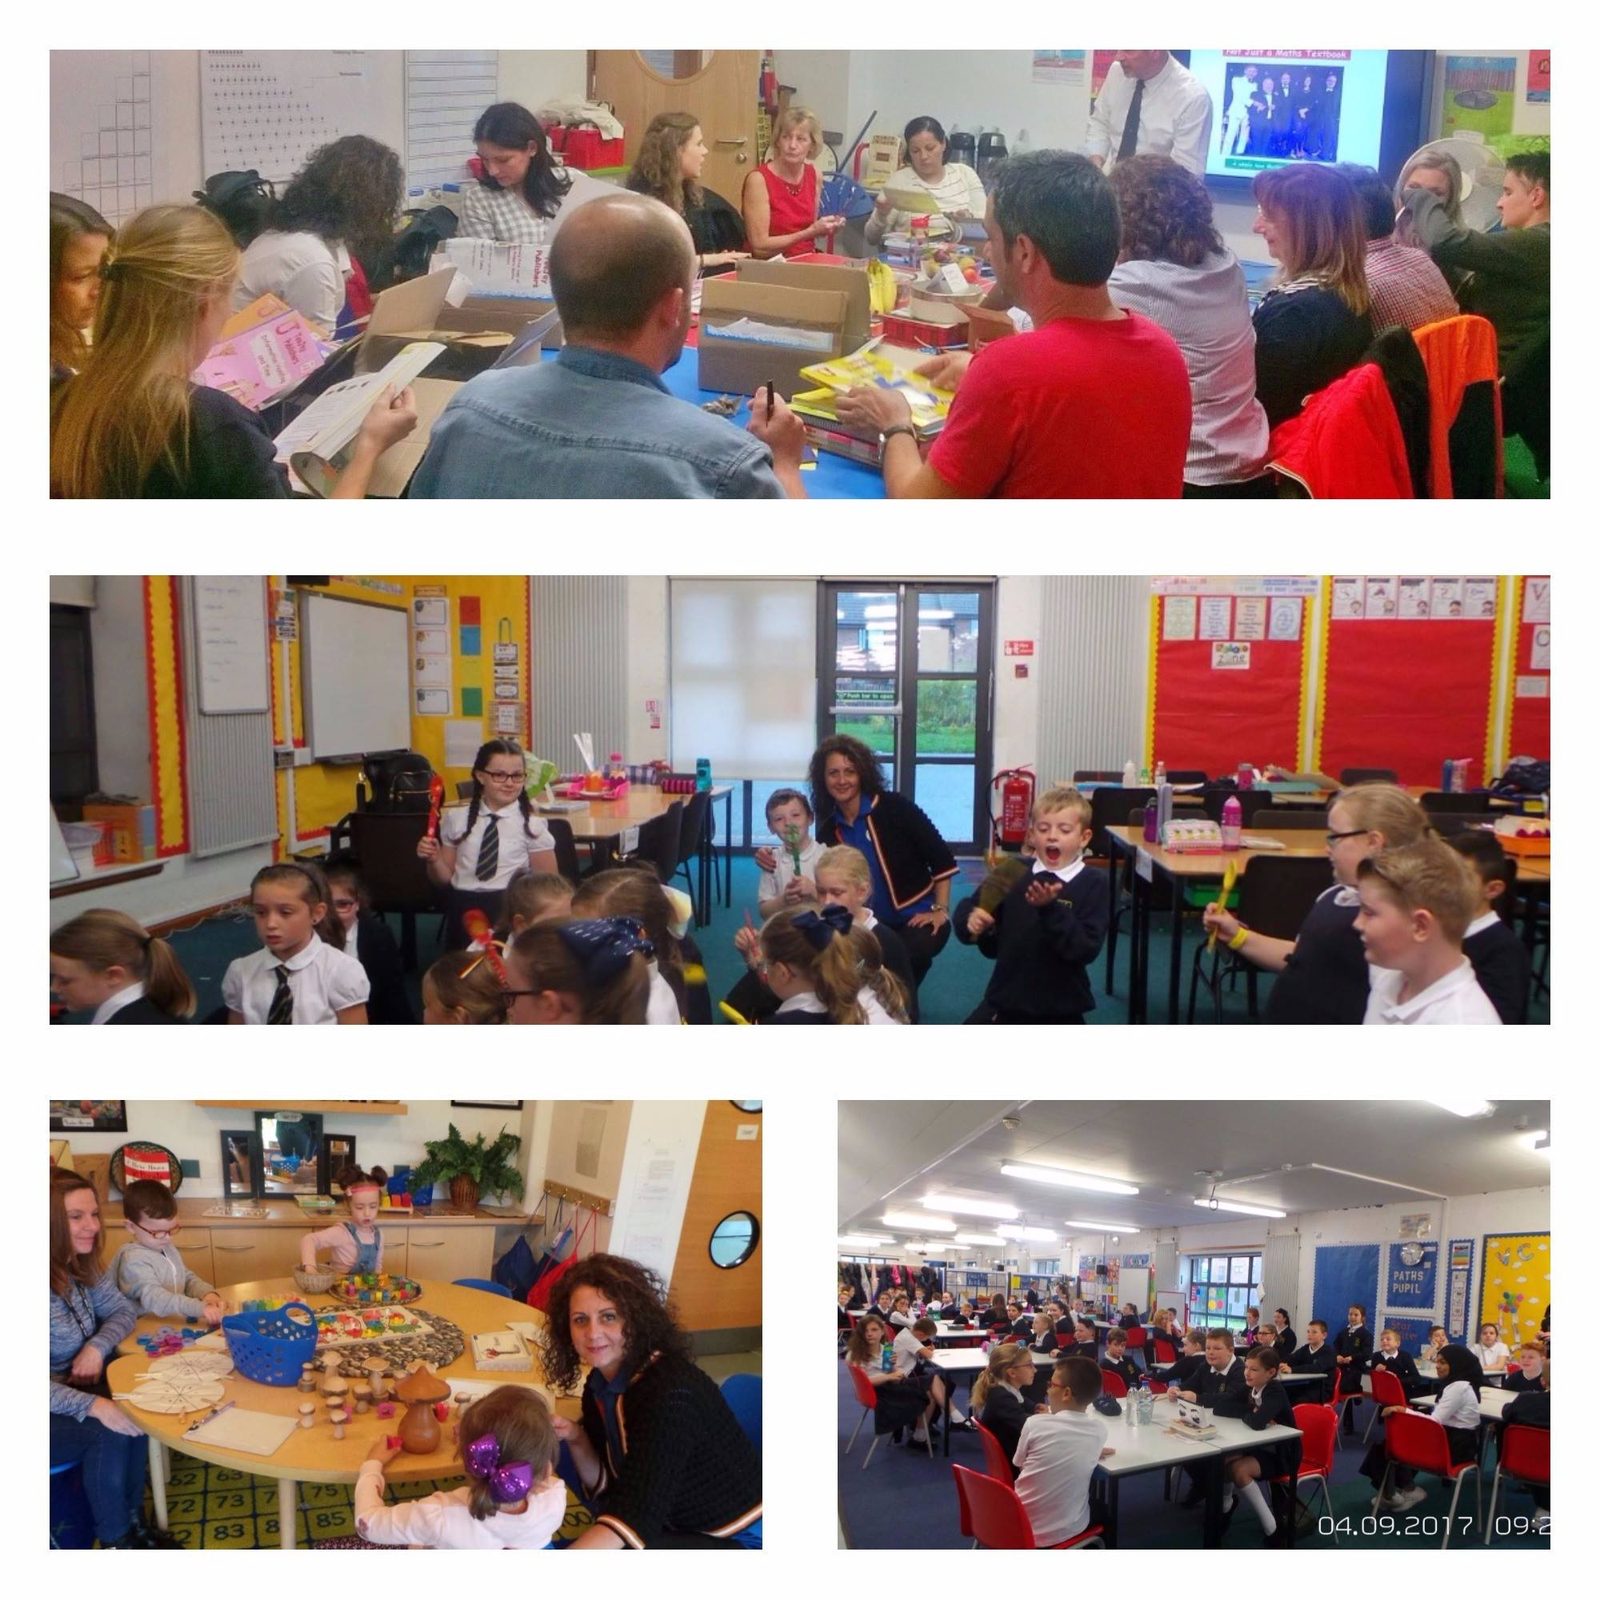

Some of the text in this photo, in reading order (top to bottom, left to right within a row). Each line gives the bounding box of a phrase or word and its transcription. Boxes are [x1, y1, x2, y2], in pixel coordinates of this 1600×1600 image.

[1275, 50, 1302, 58] Maths
[1306, 50, 1347, 59] Textbook
[533, 249, 543, 288] Publishers
[1393, 1270, 1424, 1281] PATHS
[1392, 1283, 1421, 1294] PUPIL
[169, 1472, 197, 1487] 62
[216, 1469, 243, 1482] 63
[311, 1485, 338, 1498] 75
[166, 1498, 196, 1513] 72
[216, 1494, 245, 1509] 73
[316, 1511, 347, 1528] 85
[562, 1510, 593, 1528] 00
[214, 1523, 245, 1540] 83
